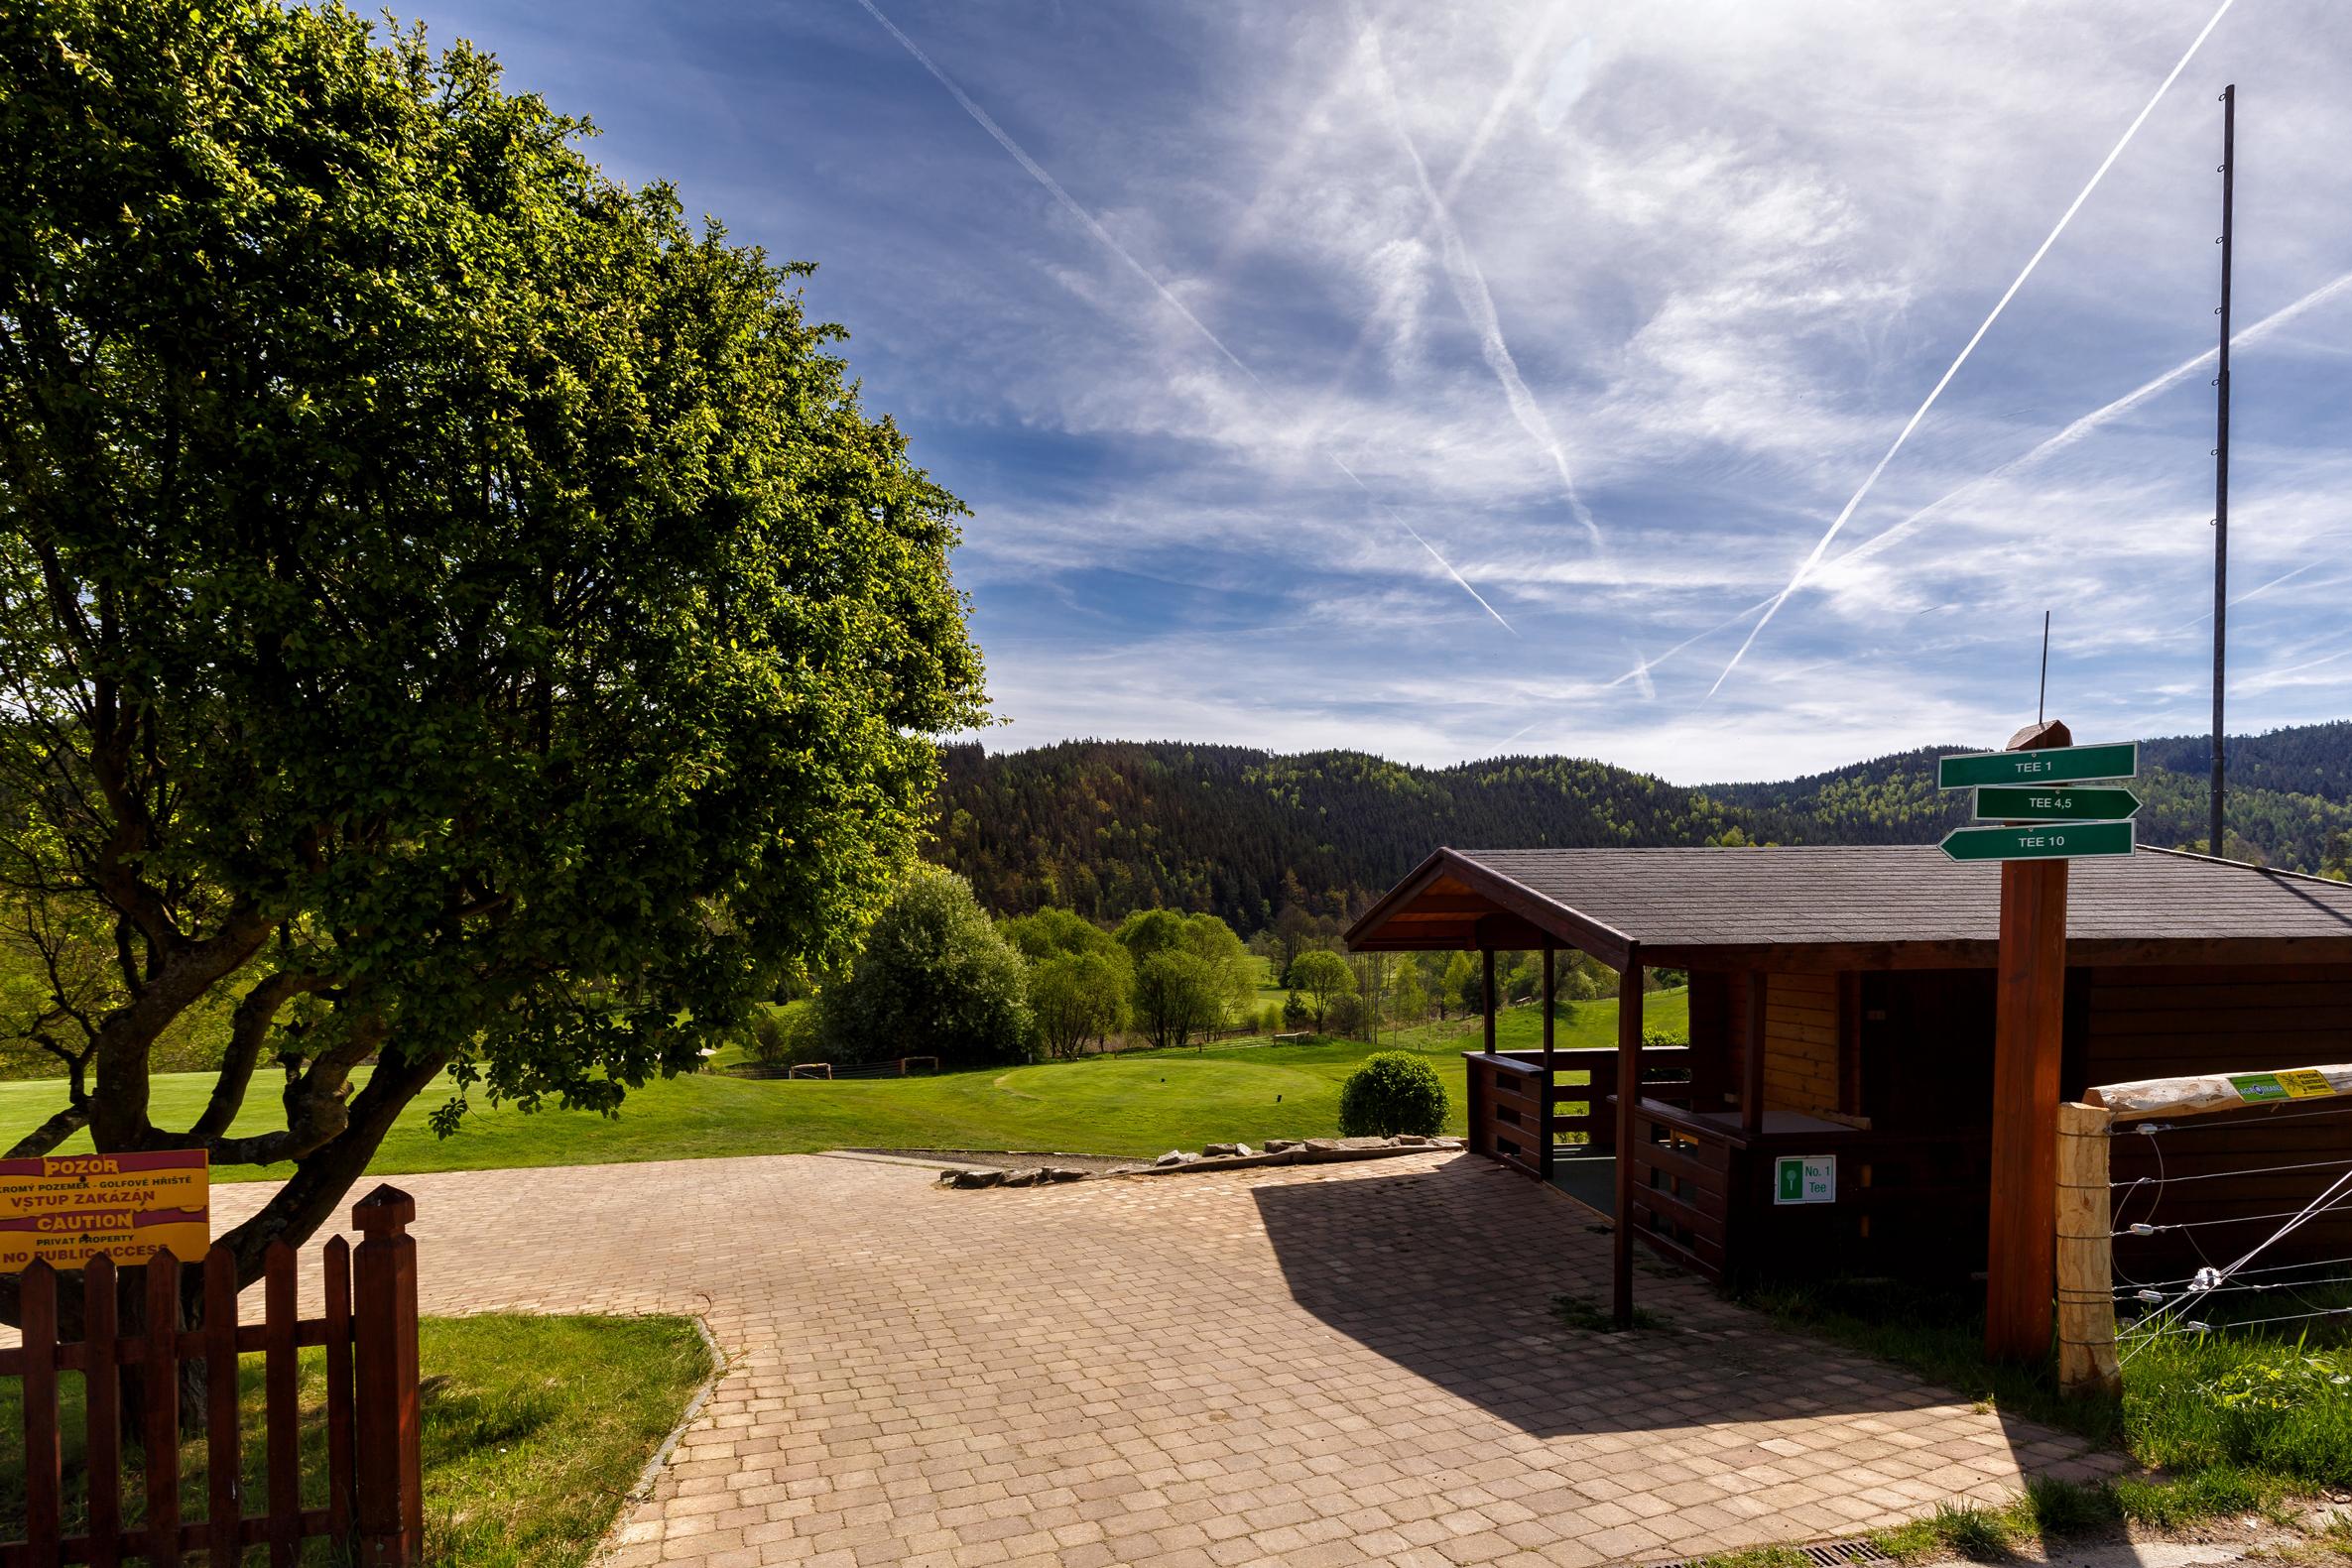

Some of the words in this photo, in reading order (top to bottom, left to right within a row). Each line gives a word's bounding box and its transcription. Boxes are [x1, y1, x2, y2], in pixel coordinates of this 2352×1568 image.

[2015, 762, 2042, 773] TEE
[2045, 762, 2052, 771] 1
[2029, 797, 2051, 808] TEE
[2054, 798, 2071, 809] 4,5
[2018, 837, 2044, 847] TEE
[2048, 836, 2064, 846] 10
[47, 1159, 119, 1176] POZOR
[1805, 1165, 1821, 1177] No.
[1825, 1165, 1830, 1175] 1
[39, 1182, 89, 1192] POZEMEK
[99, 1177, 149, 1188] GOLFOVÉ
[1808, 1181, 1826, 1193] Tee
[12, 1195, 68, 1207] VSTUP
[74, 1188, 155, 1205] ZAKÁZÁN
[37, 1213, 133, 1231] CAUTION
[79, 1235, 135, 1244] PROPERTY
[3, 1252, 28, 1264] NO
